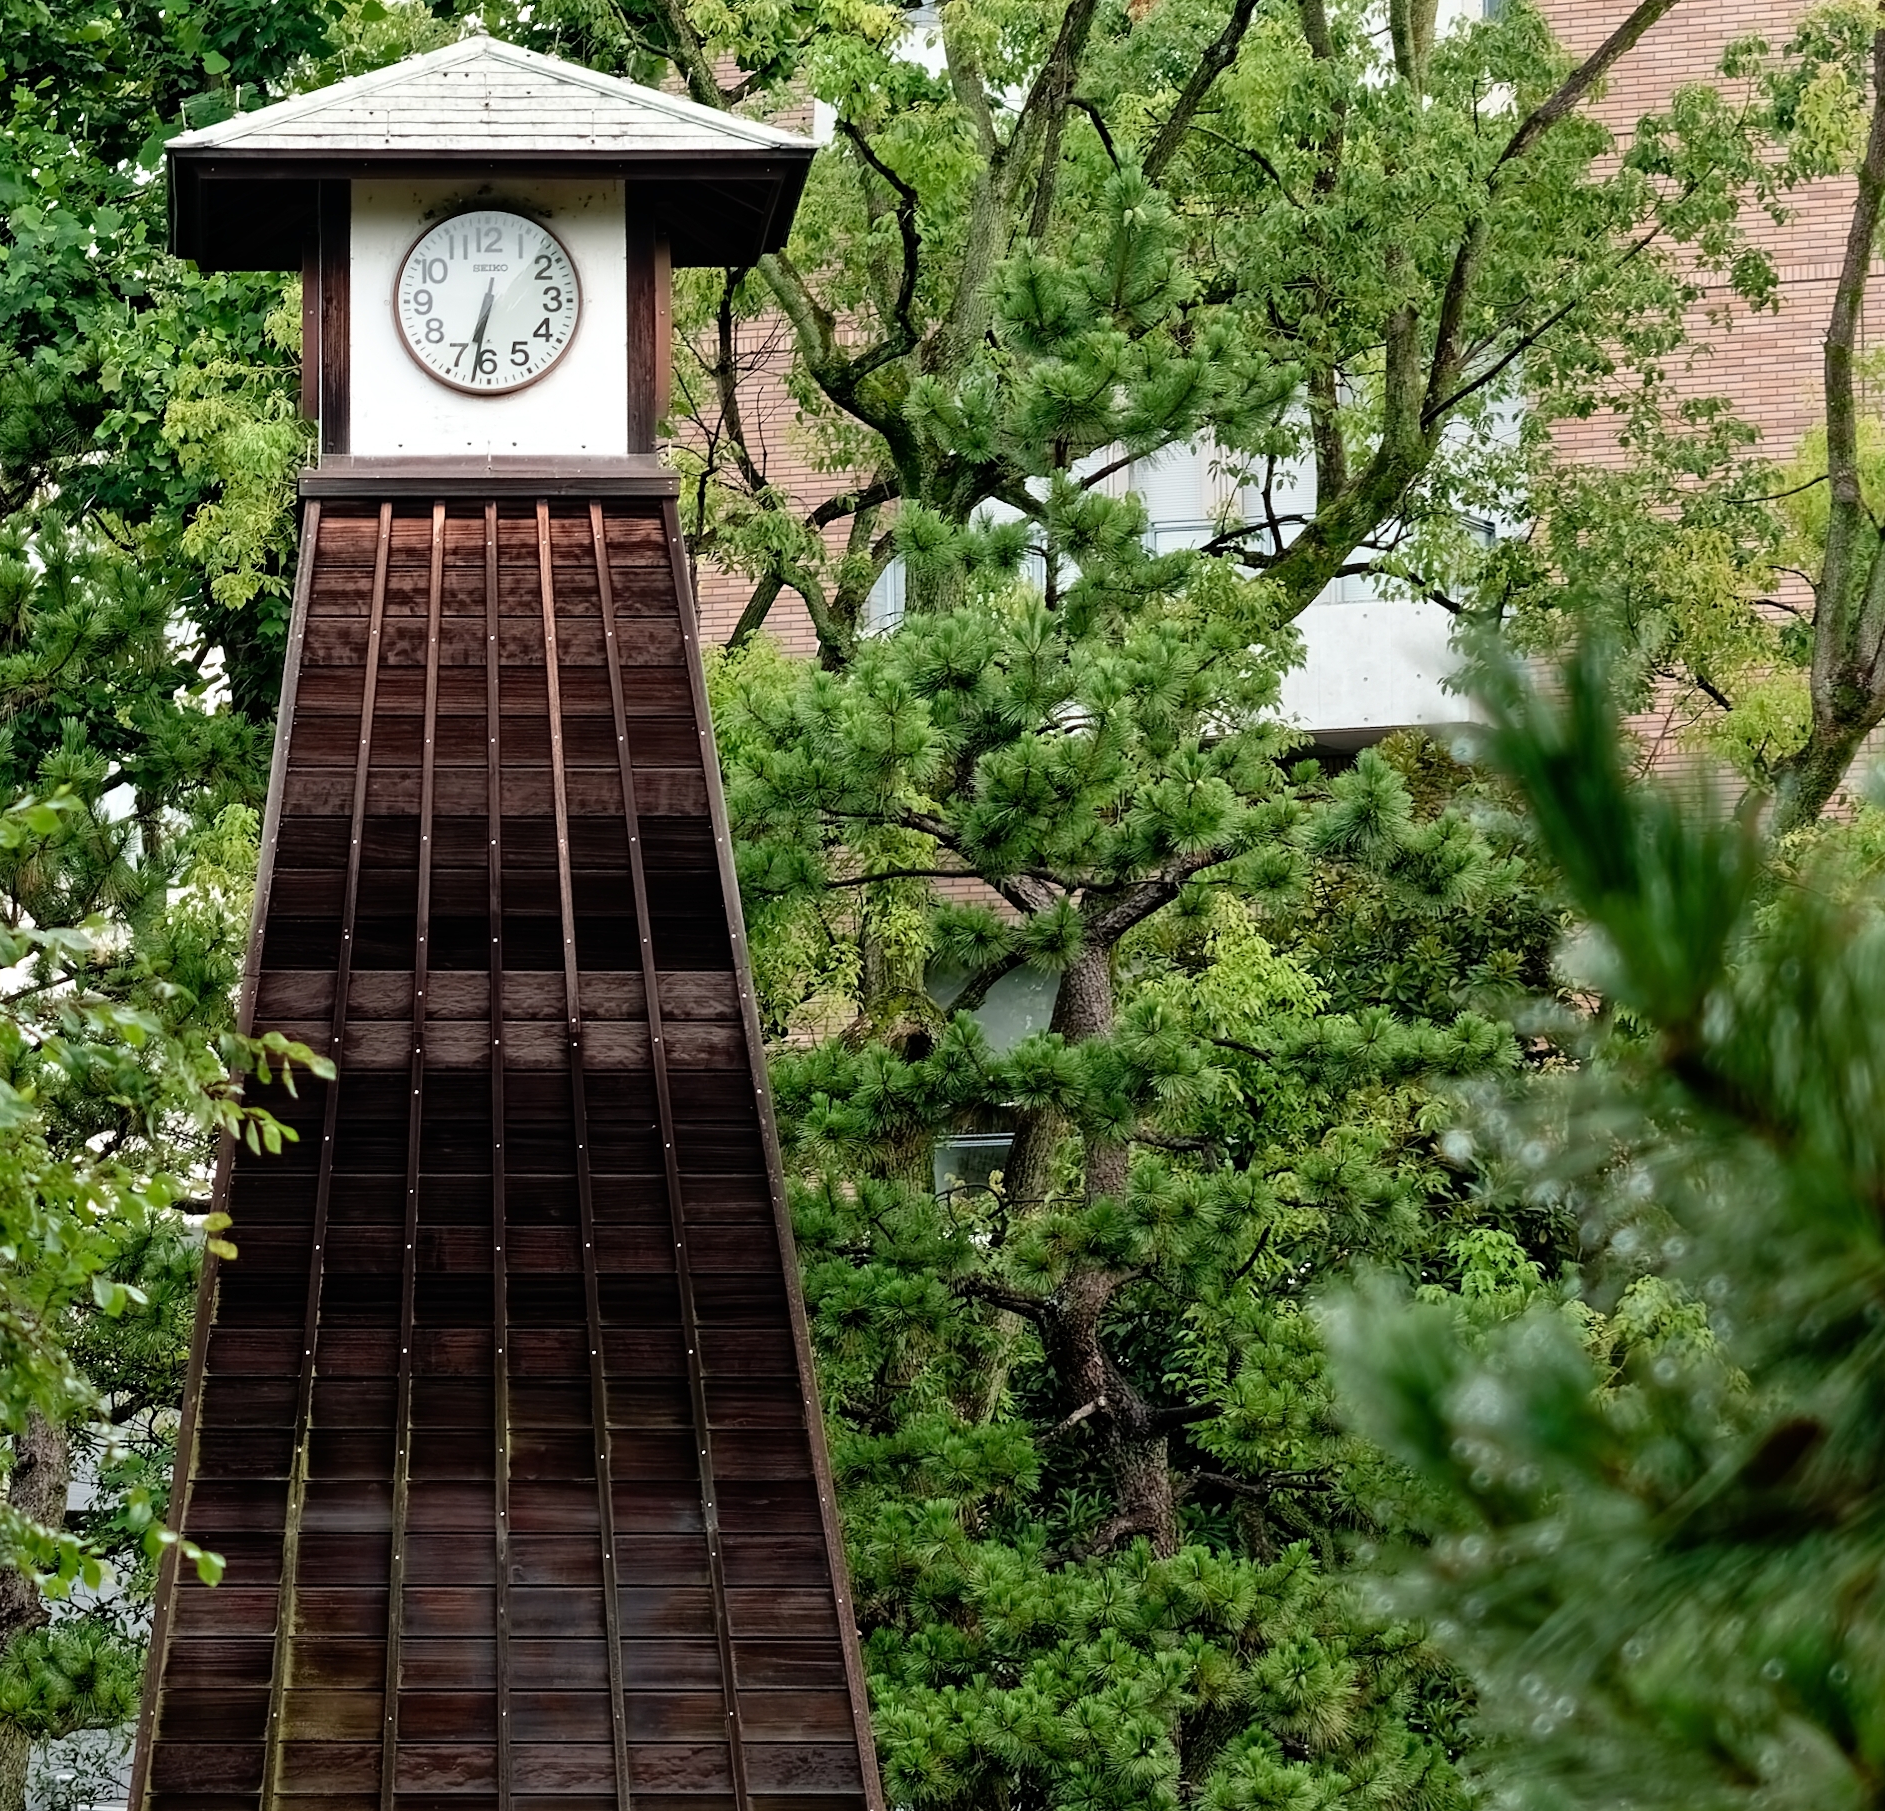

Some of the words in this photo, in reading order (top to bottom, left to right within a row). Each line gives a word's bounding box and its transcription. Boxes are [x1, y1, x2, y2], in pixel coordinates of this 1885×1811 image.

[449, 234, 468, 260] 11
[476, 227, 503, 253] 12
[422, 257, 448, 284] 10
[472, 263, 509, 272] SEIKO
[534, 255, 553, 280] 2
[413, 289, 433, 315] 9
[542, 286, 562, 312] 3
[425, 318, 445, 344] 8
[533, 317, 553, 343] 4
[449, 342, 469, 367] 7
[478, 349, 497, 375] 6
[510, 341, 530, 366] 5
